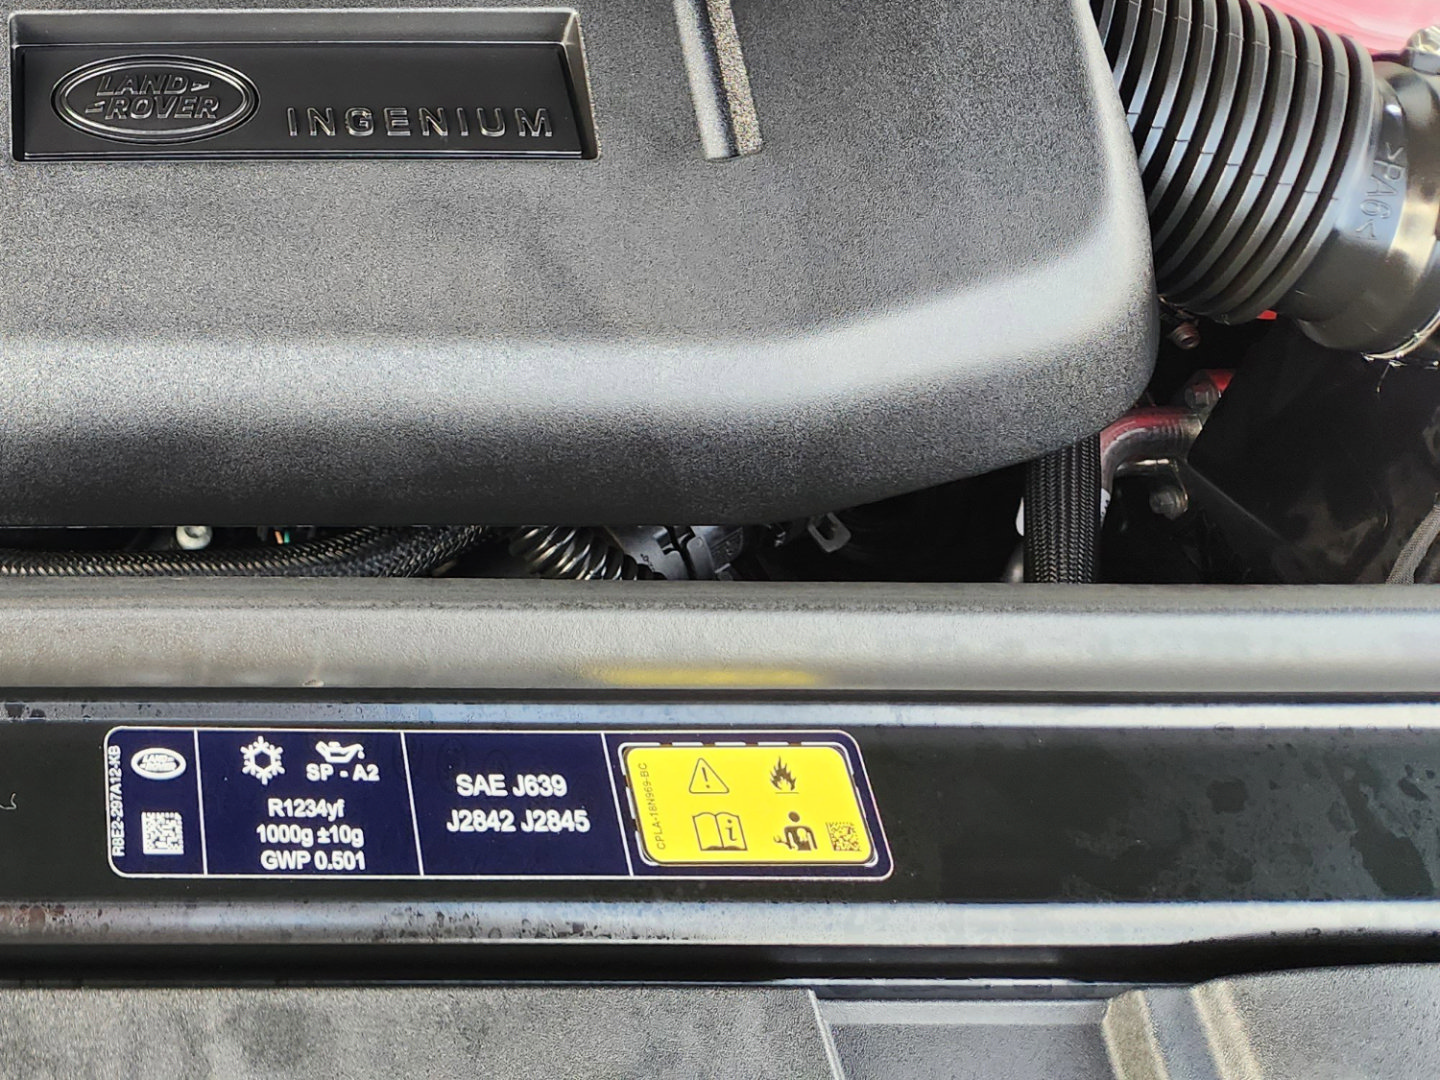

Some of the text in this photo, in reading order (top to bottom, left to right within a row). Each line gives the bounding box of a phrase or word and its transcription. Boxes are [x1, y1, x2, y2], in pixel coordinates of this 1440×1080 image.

[96, 74, 190, 95] LAND
[104, 96, 220, 120] ROVER
[286, 106, 554, 137] INGENIUM
[306, 764, 335, 782] SP
[352, 764, 380, 782] A2
[455, 774, 568, 798] SAE J639
[267, 798, 345, 820] R1234yf
[446, 809, 591, 834] J2842 J2845
[256, 825, 364, 848] 1000g ±10g
[260, 850, 366, 872] GWP 0.501
